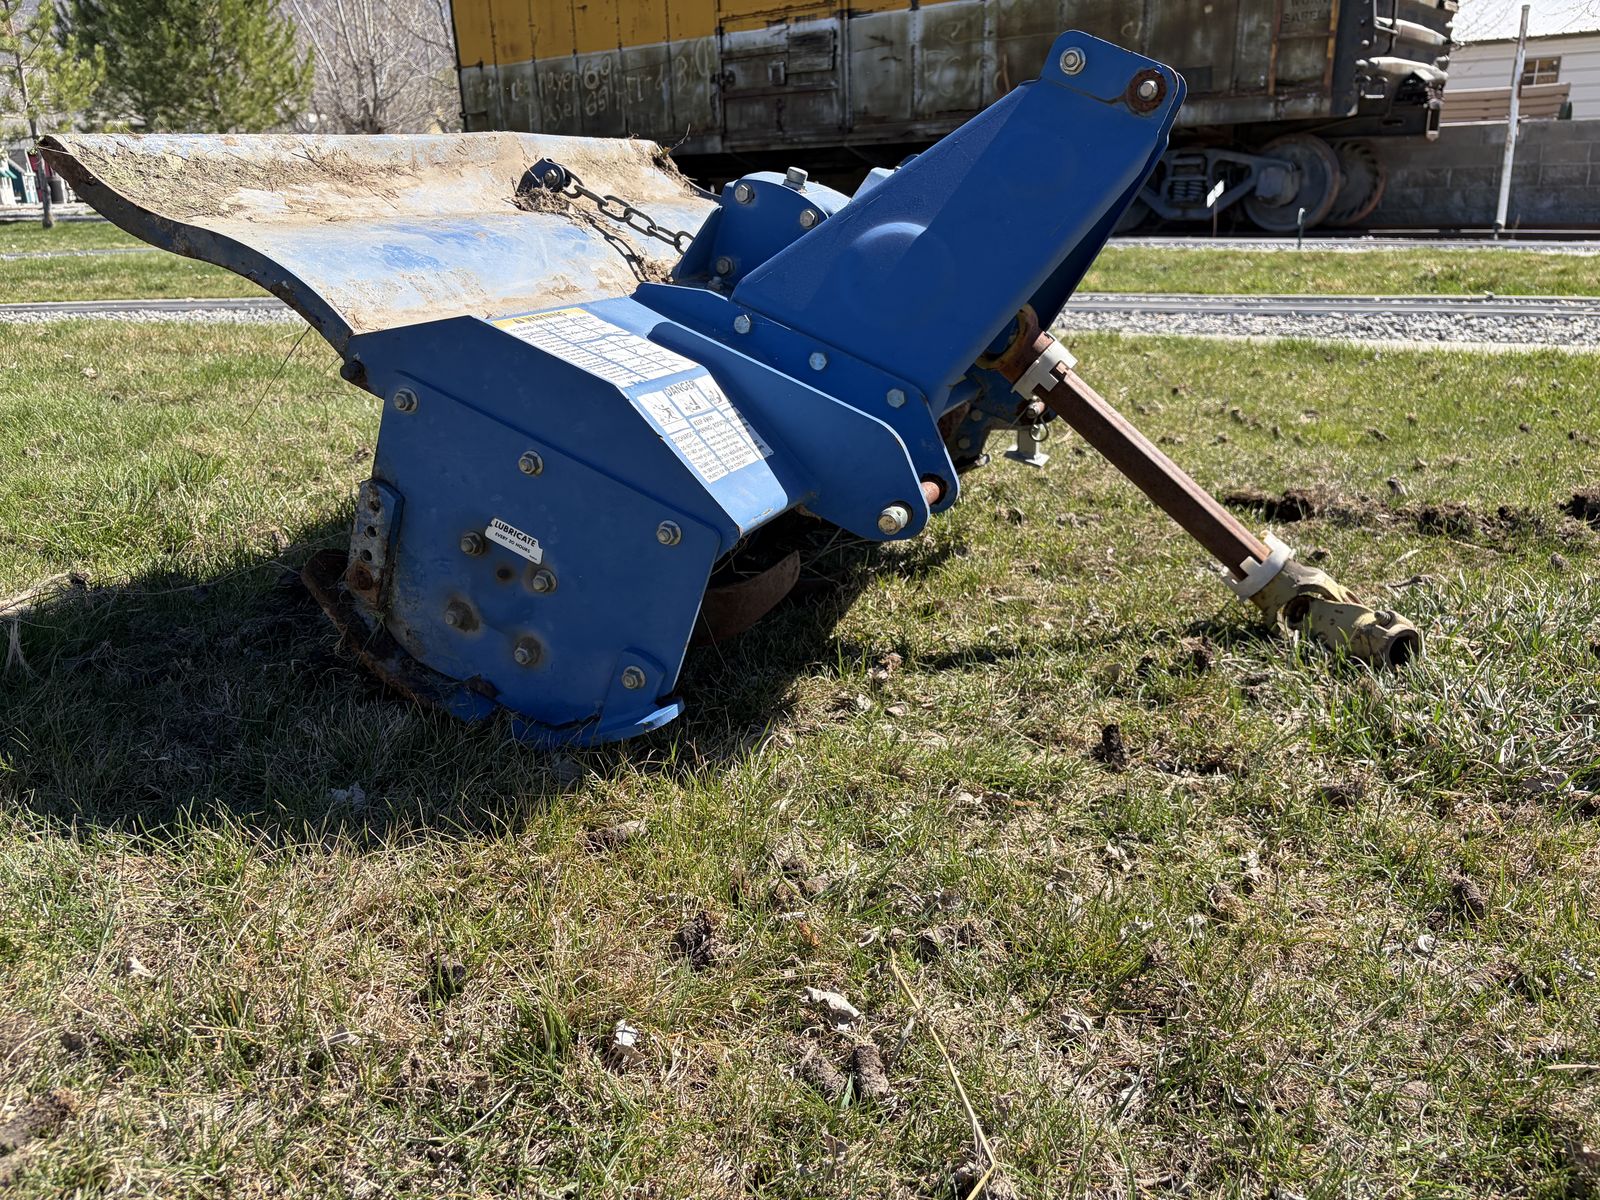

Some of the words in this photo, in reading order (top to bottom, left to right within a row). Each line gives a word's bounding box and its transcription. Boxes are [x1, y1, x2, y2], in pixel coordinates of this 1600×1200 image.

[664, 380, 696, 397] DANGER
[494, 520, 537, 548] LUBRICATE
[494, 531, 508, 541] EVERY
[515, 543, 531, 553] HOURS
